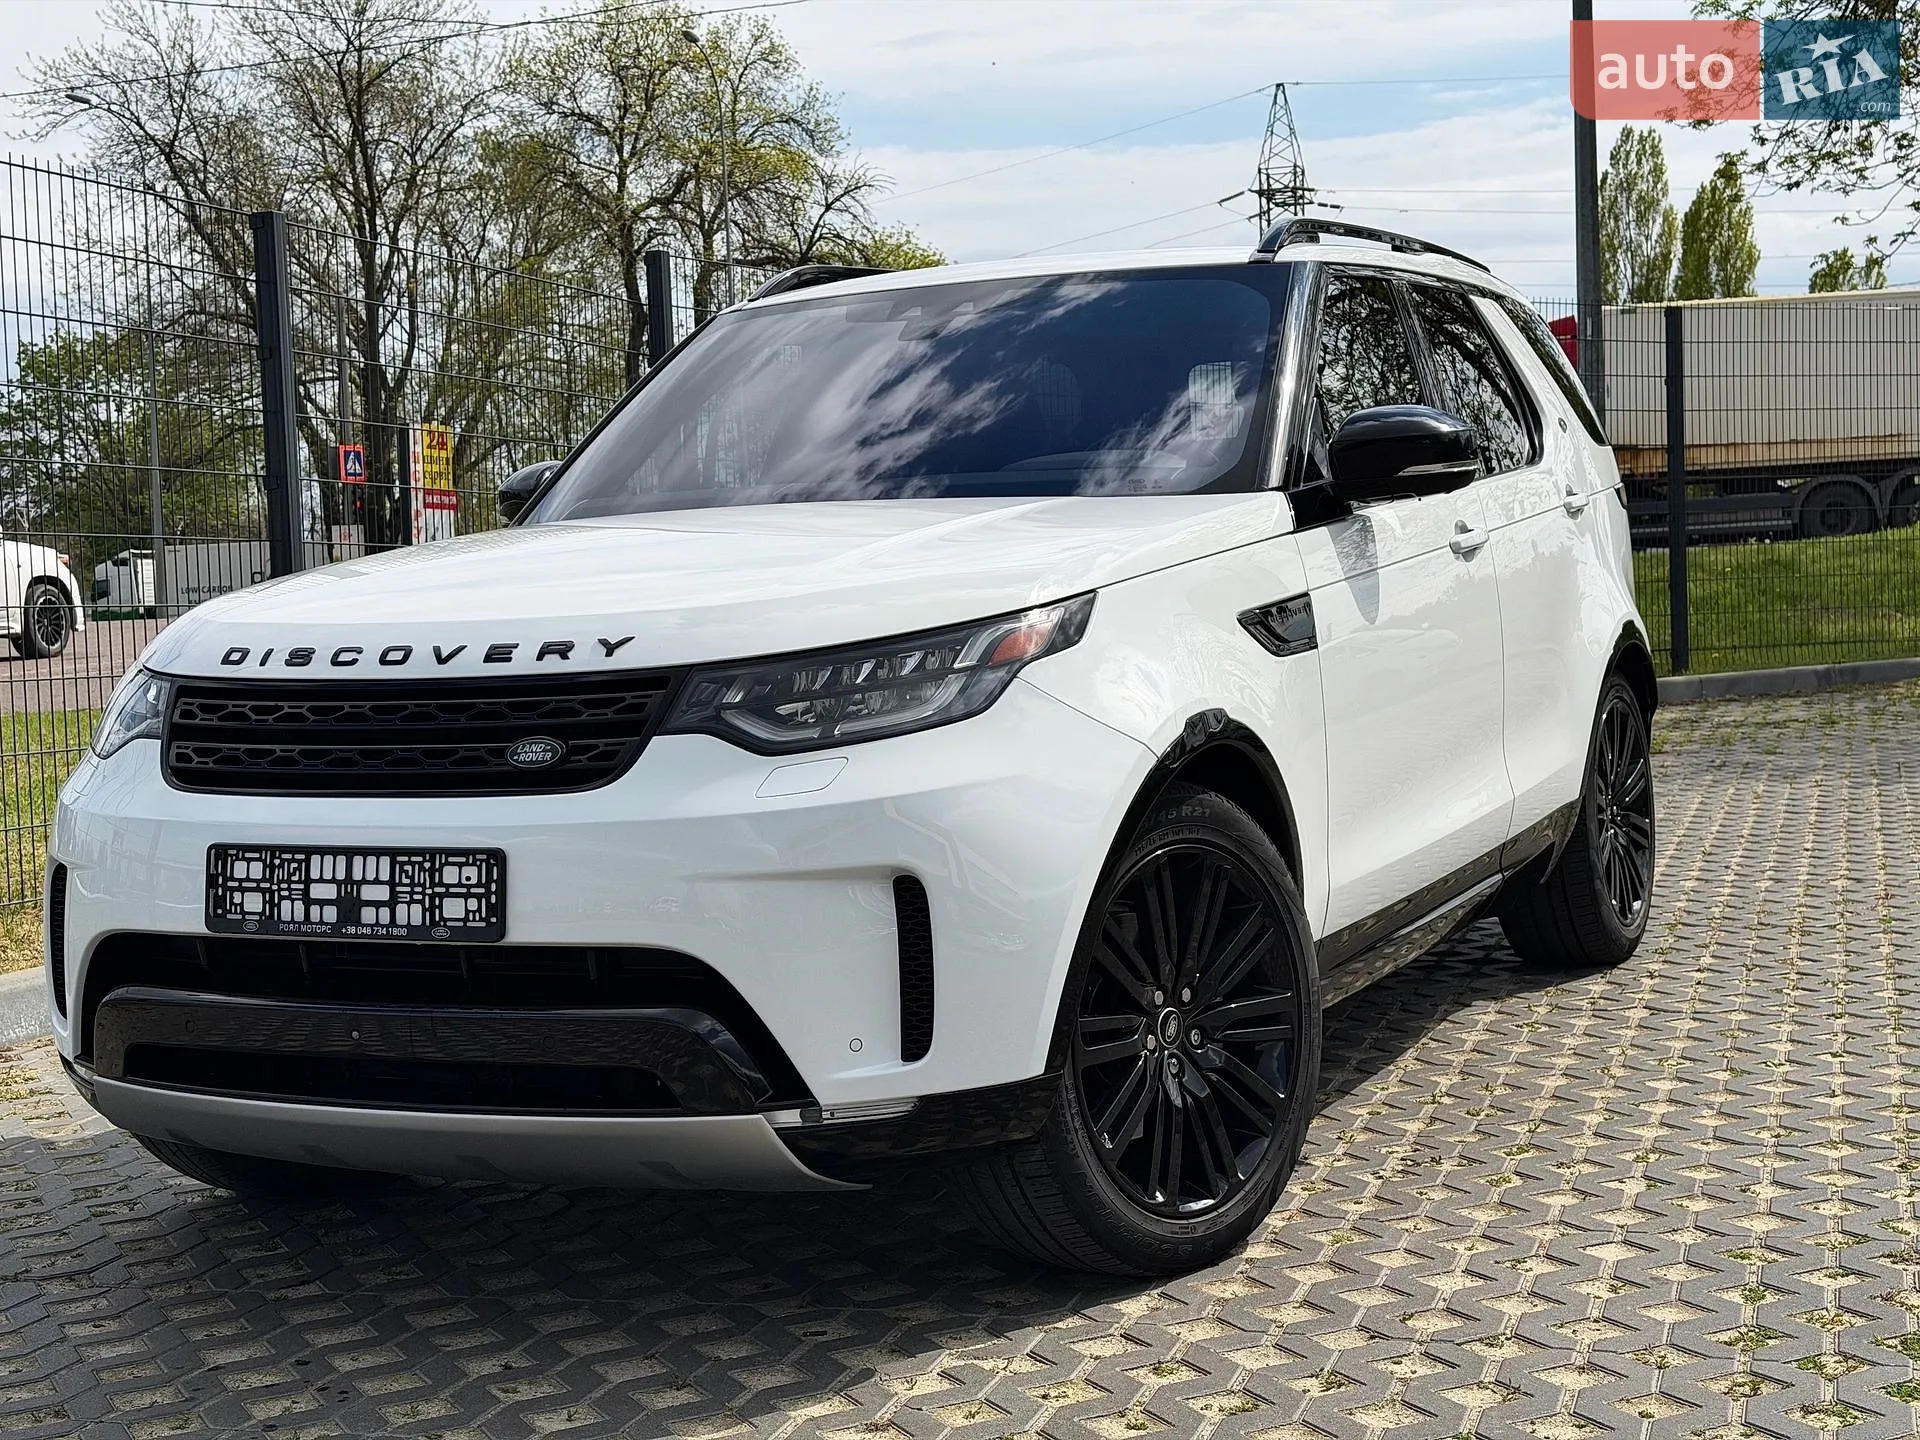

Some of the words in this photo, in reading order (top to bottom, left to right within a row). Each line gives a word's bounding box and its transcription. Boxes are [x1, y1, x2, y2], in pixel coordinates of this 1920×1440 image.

[220, 635, 636, 667] DISCOVERY
[279, 923, 299, 932] РОЯЛ
[300, 924, 332, 933] МОТОРС
[341, 926, 356, 934] +38
[373, 927, 387, 936] 734
